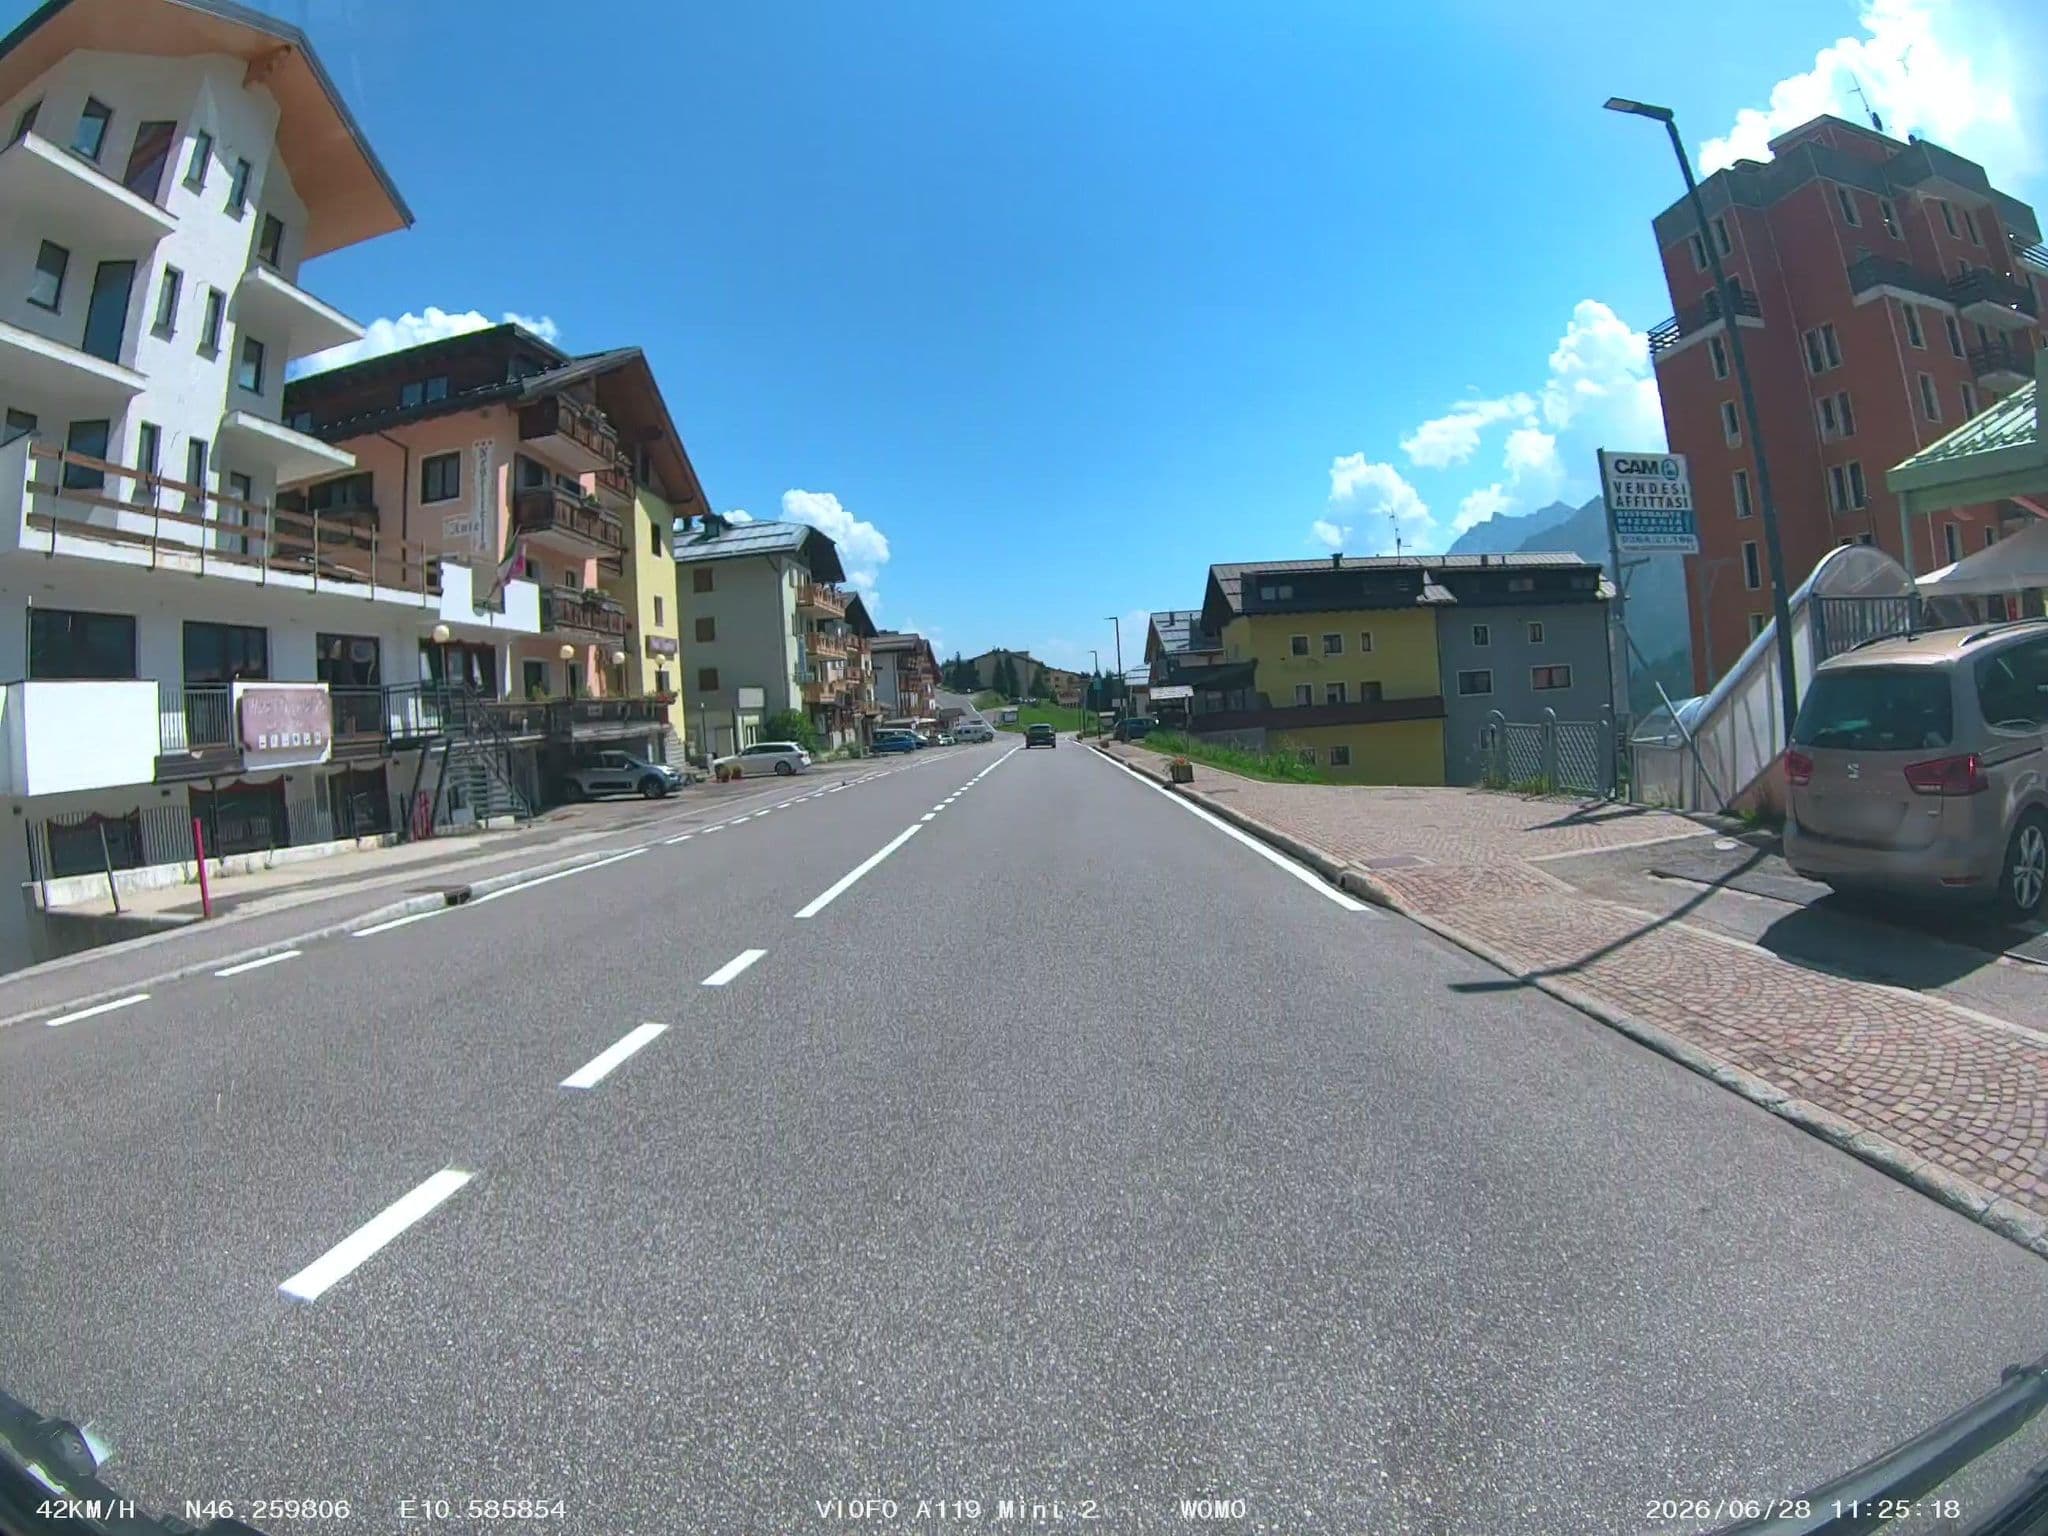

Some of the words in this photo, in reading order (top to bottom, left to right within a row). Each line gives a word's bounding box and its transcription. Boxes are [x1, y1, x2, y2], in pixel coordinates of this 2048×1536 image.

[1614, 459, 1659, 475] CAM
[1613, 481, 1687, 495] VENDESI
[1615, 496, 1689, 508] AFFITTASI
